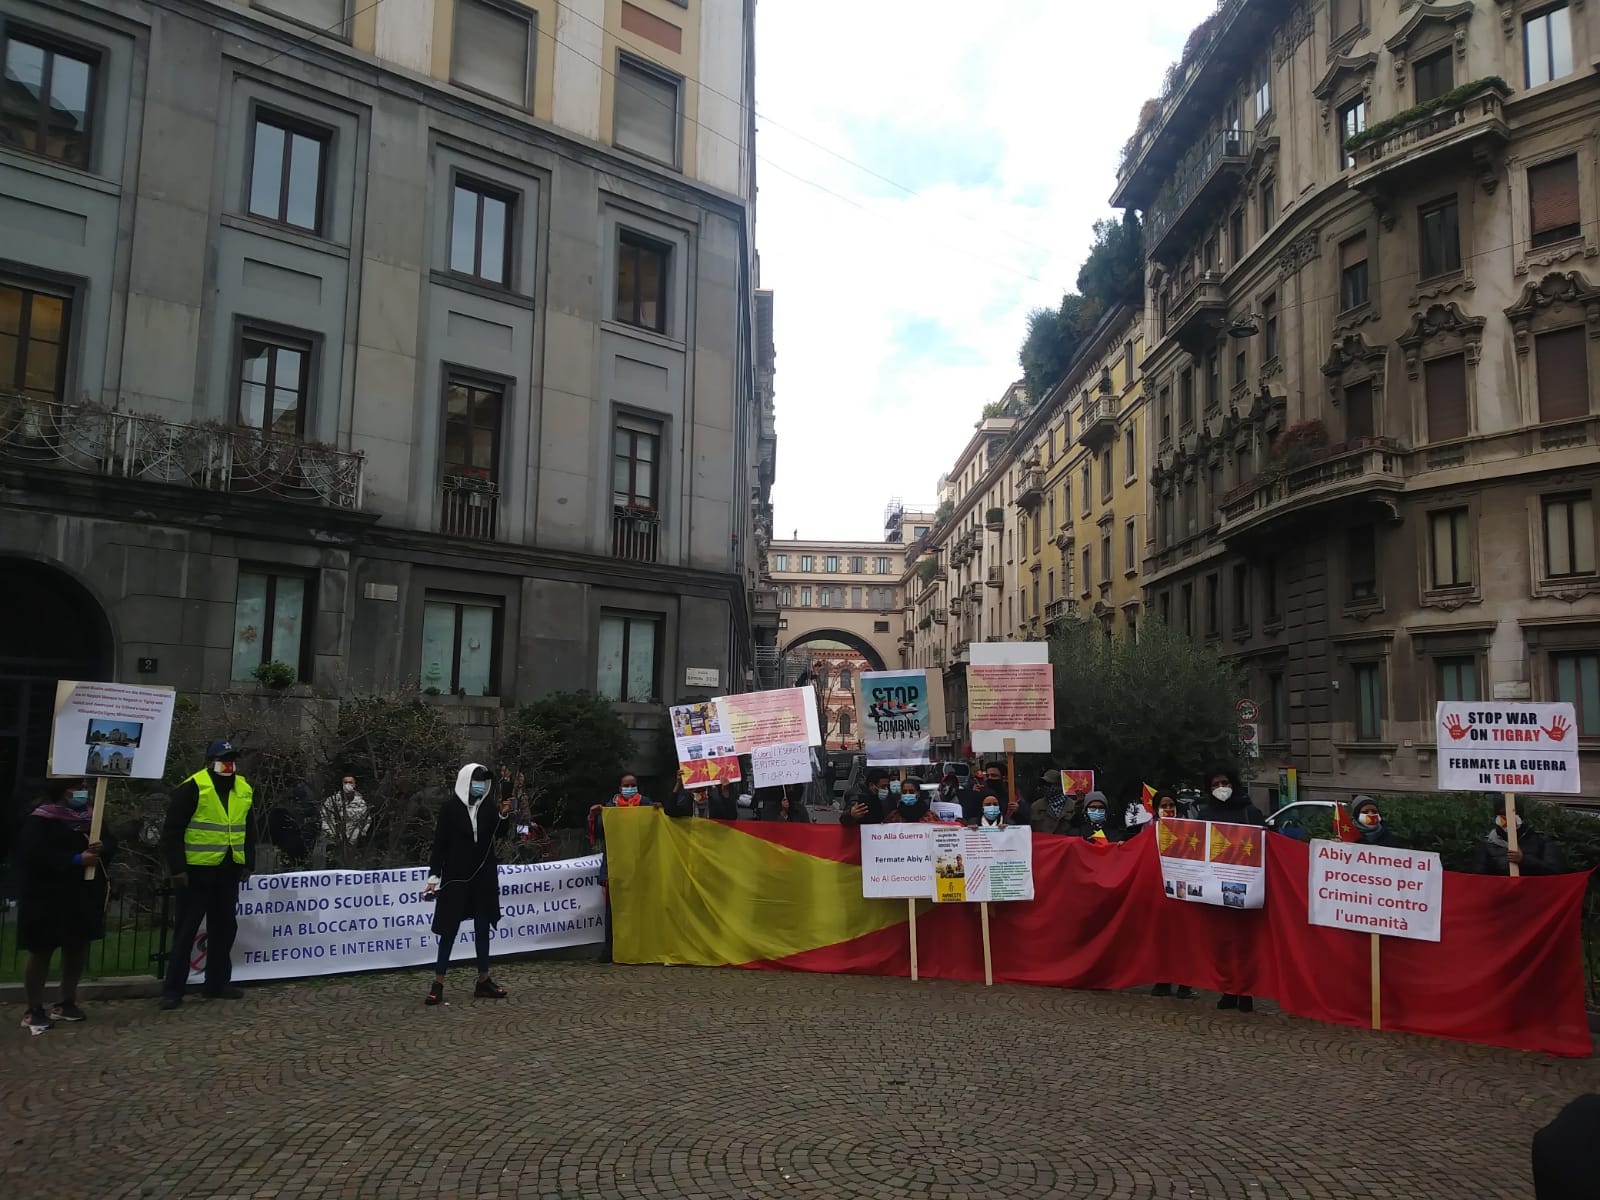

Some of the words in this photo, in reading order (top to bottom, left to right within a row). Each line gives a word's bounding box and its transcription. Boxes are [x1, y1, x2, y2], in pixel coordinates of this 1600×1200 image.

[145, 659, 152, 670] 2
[872, 686, 919, 710] STOP
[1468, 712, 1502, 725] STOP
[1506, 712, 1537, 725] WAR
[877, 719, 921, 733] BOMBING
[877, 731, 921, 740] TIGRAY
[1470, 729, 1488, 741] ON
[1492, 729, 1540, 742] TIGRAY
[1449, 758, 1500, 770] FERMATE
[1504, 759, 1517, 770] LA
[1520, 760, 1567, 771] GUERRA
[1479, 773, 1491, 784] IN
[1494, 774, 1535, 785] TIGRAI
[899, 832, 923, 840] Guerra
[907, 855, 923, 864] Abiy
[1319, 847, 1352, 865] Abiy
[1357, 851, 1412, 869] Ahmed
[1417, 858, 1431, 871] al
[241, 879, 253, 891] IL
[258, 875, 331, 890] GOVERNO
[336, 870, 407, 886] FEDERALE
[891, 874, 926, 882] Genocidio
[1325, 870, 1392, 887] processo
[1397, 879, 1423, 891] per
[334, 894, 394, 908] SCUOLE,
[1319, 887, 1372, 905] Crimini
[1377, 897, 1428, 912] contro
[272, 925, 293, 938] HA
[298, 918, 378, 935] BLOCCATO
[382, 913, 434, 929] TIGRAY
[543, 898, 581, 913] LUCE,
[1335, 909, 1408, 931] l'umanità
[244, 944, 325, 964] TELEFONO
[330, 944, 337, 956] E
[342, 937, 412, 955] INTERNET
[420, 935, 432, 948] E'
[500, 927, 514, 939] DI
[518, 914, 602, 937] CRIMINALITÀ
